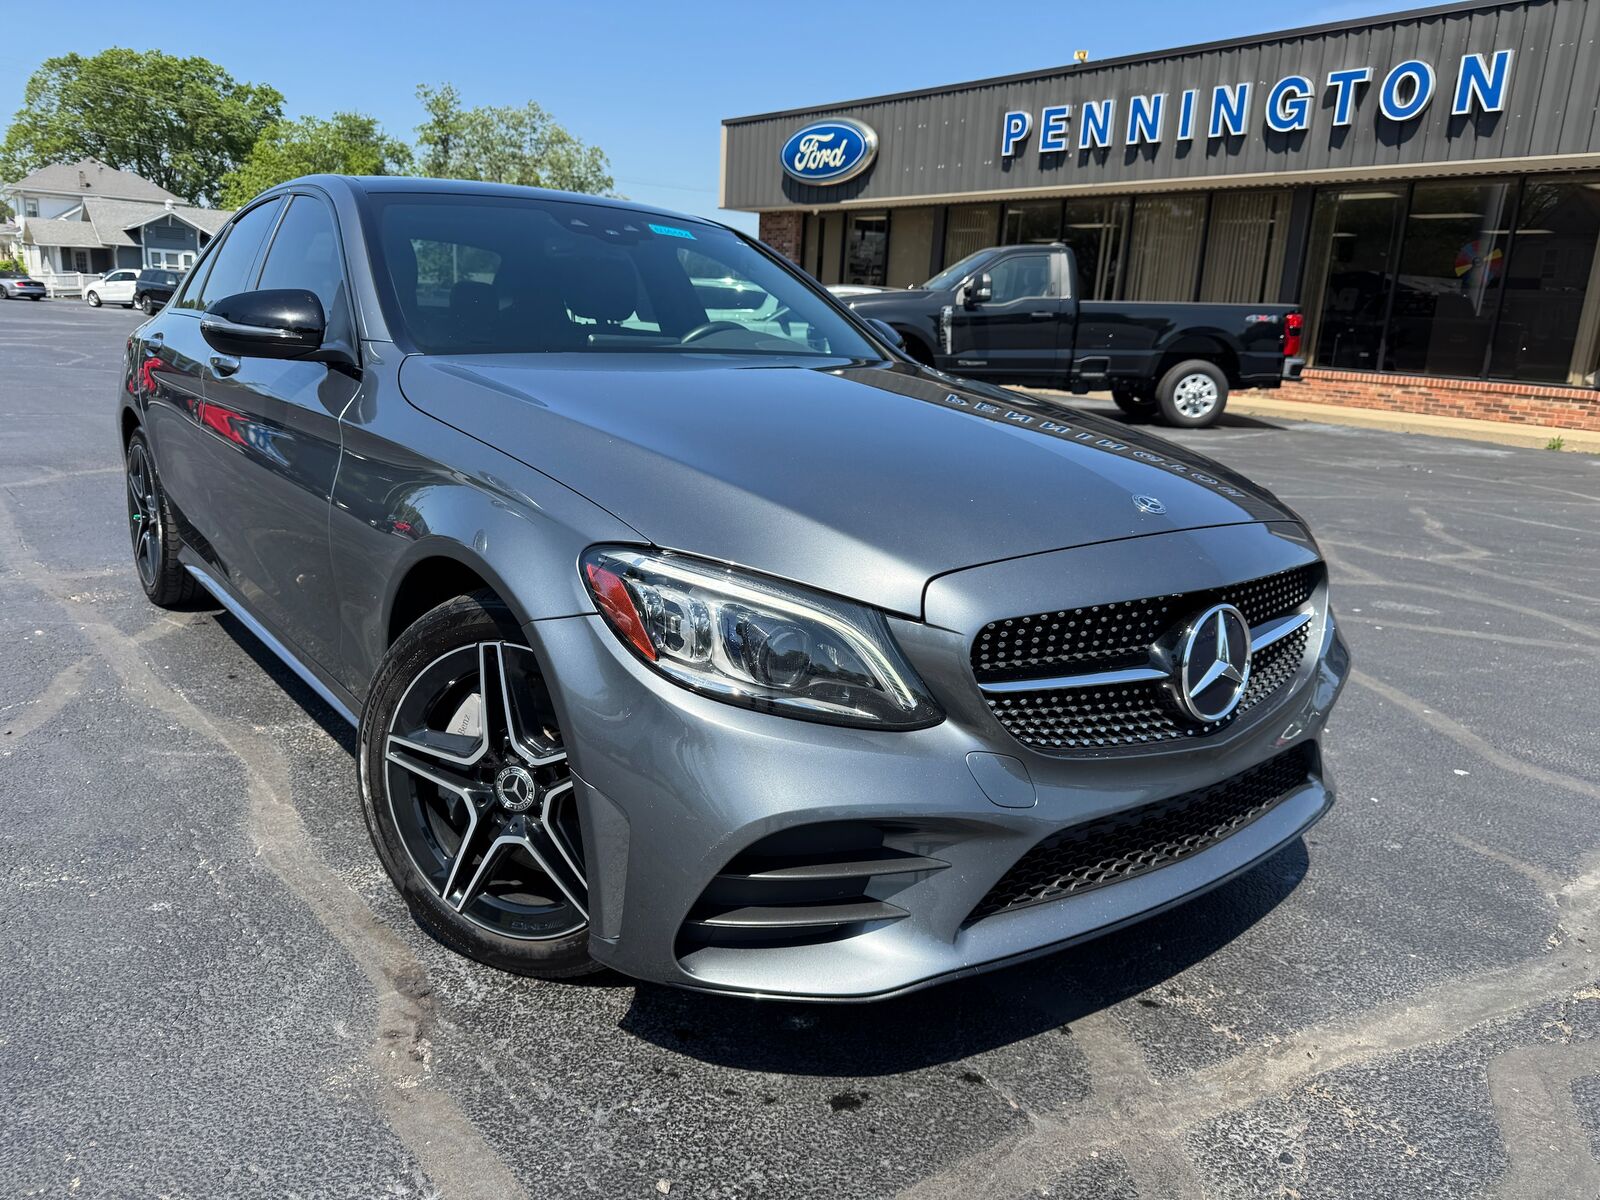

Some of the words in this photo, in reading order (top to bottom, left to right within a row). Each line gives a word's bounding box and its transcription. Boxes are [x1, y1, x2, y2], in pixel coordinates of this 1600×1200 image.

[1002, 49, 1515, 157] PENNINGTON
[794, 133, 848, 171] Ford
[457, 713, 471, 736] Benz
